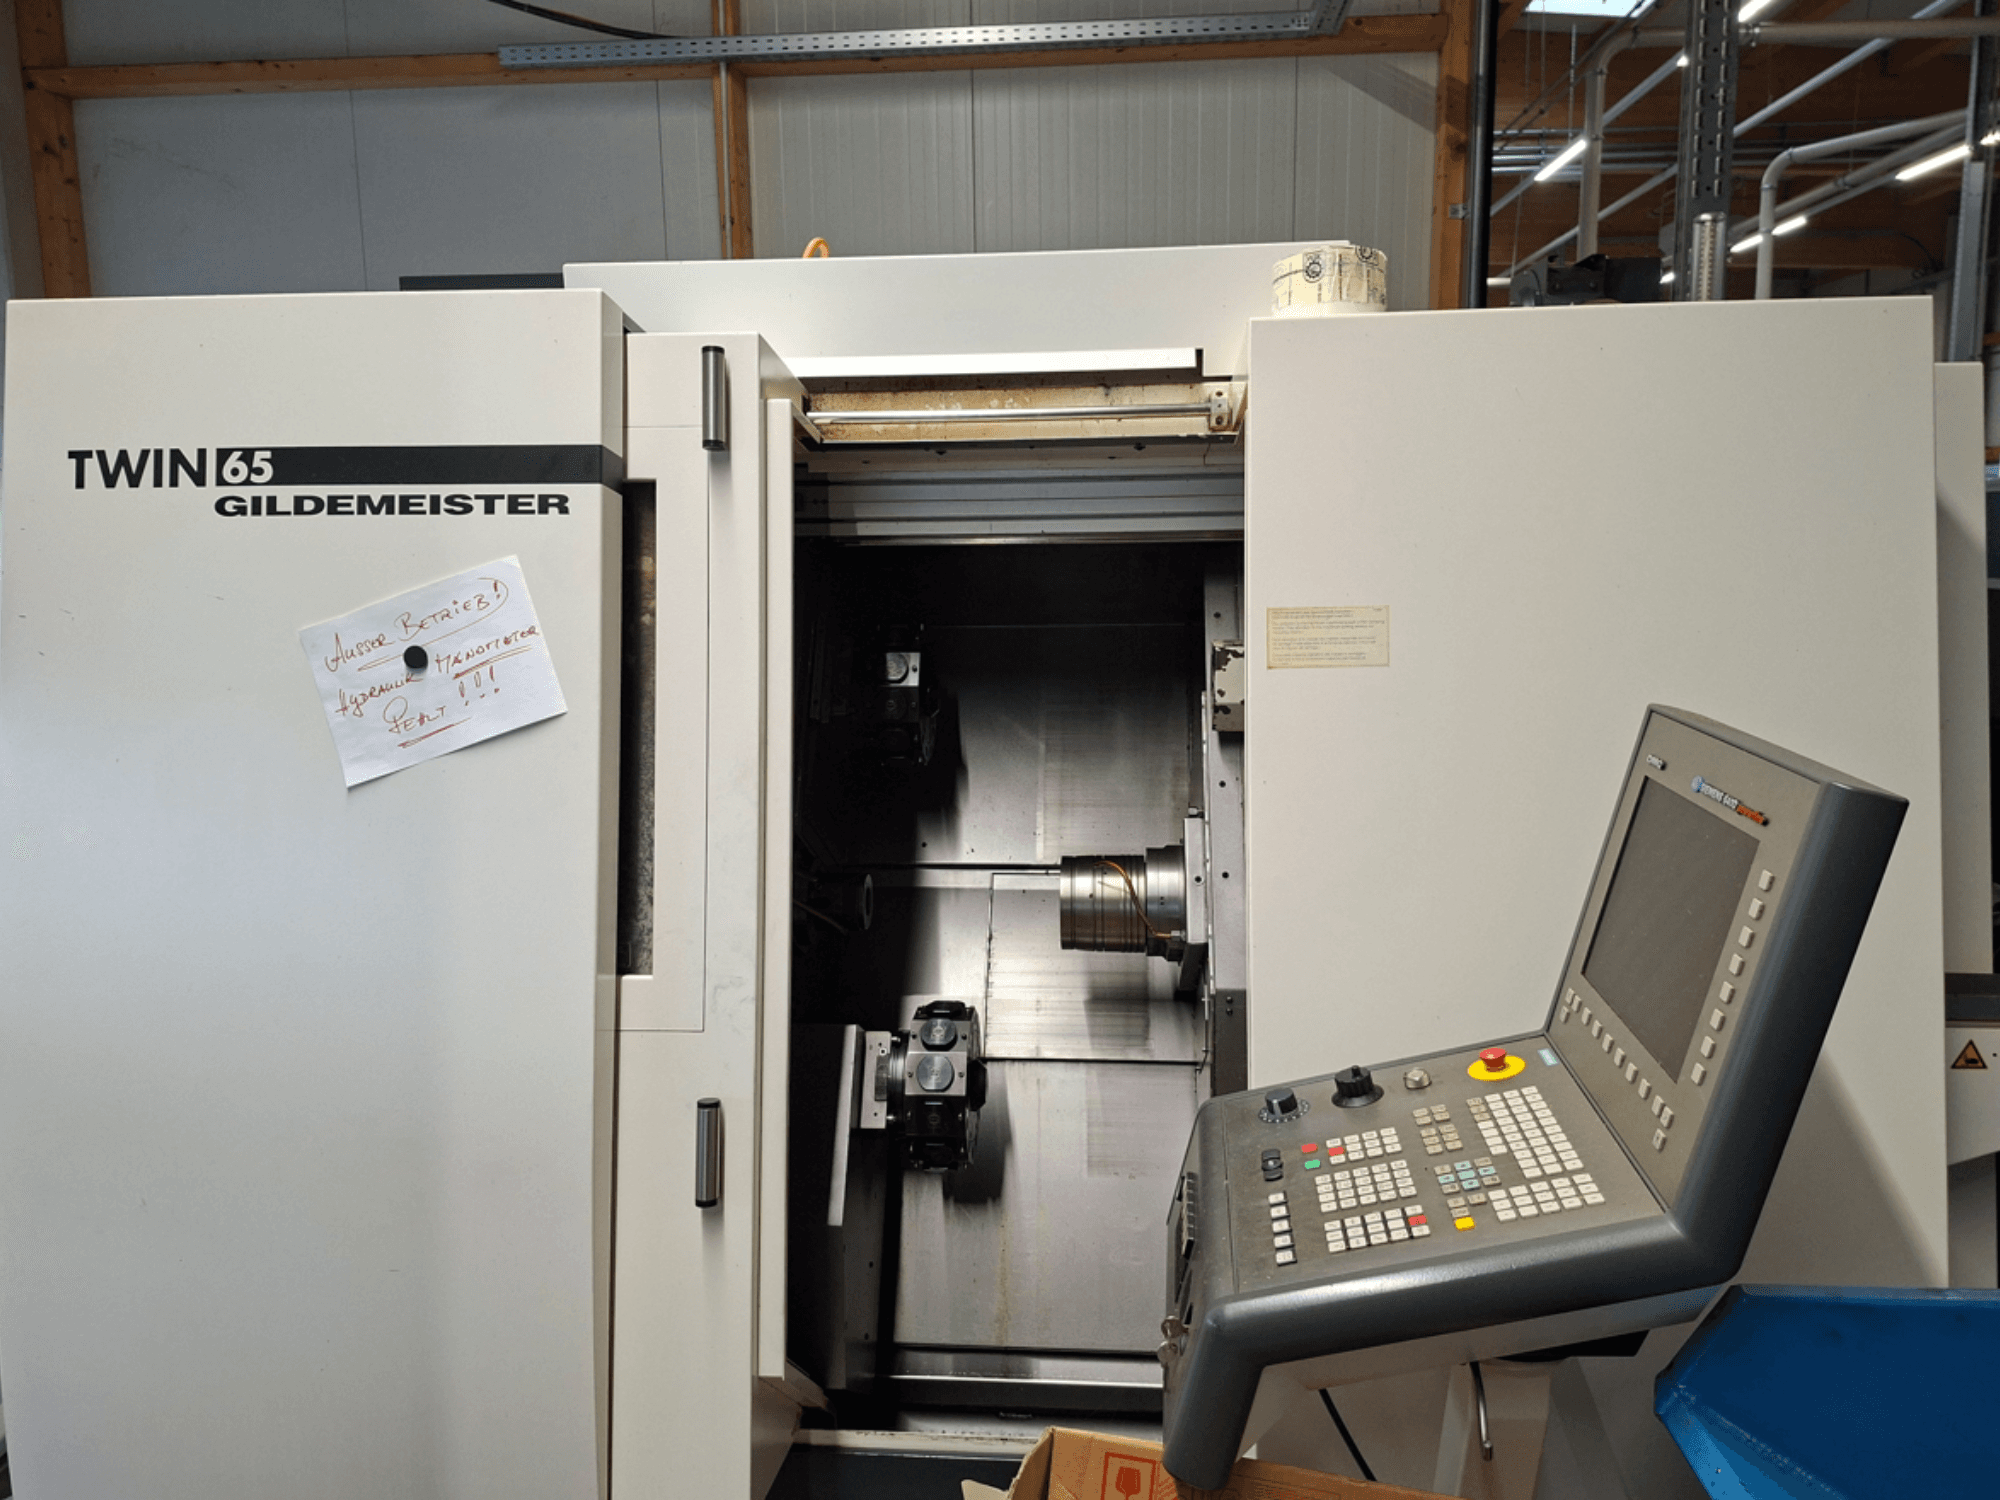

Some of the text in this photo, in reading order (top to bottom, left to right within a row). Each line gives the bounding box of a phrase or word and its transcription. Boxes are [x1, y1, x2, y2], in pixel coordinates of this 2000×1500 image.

[68, 447, 273, 489] TWIN 65
[214, 494, 570, 517] GILDEMEISTER
